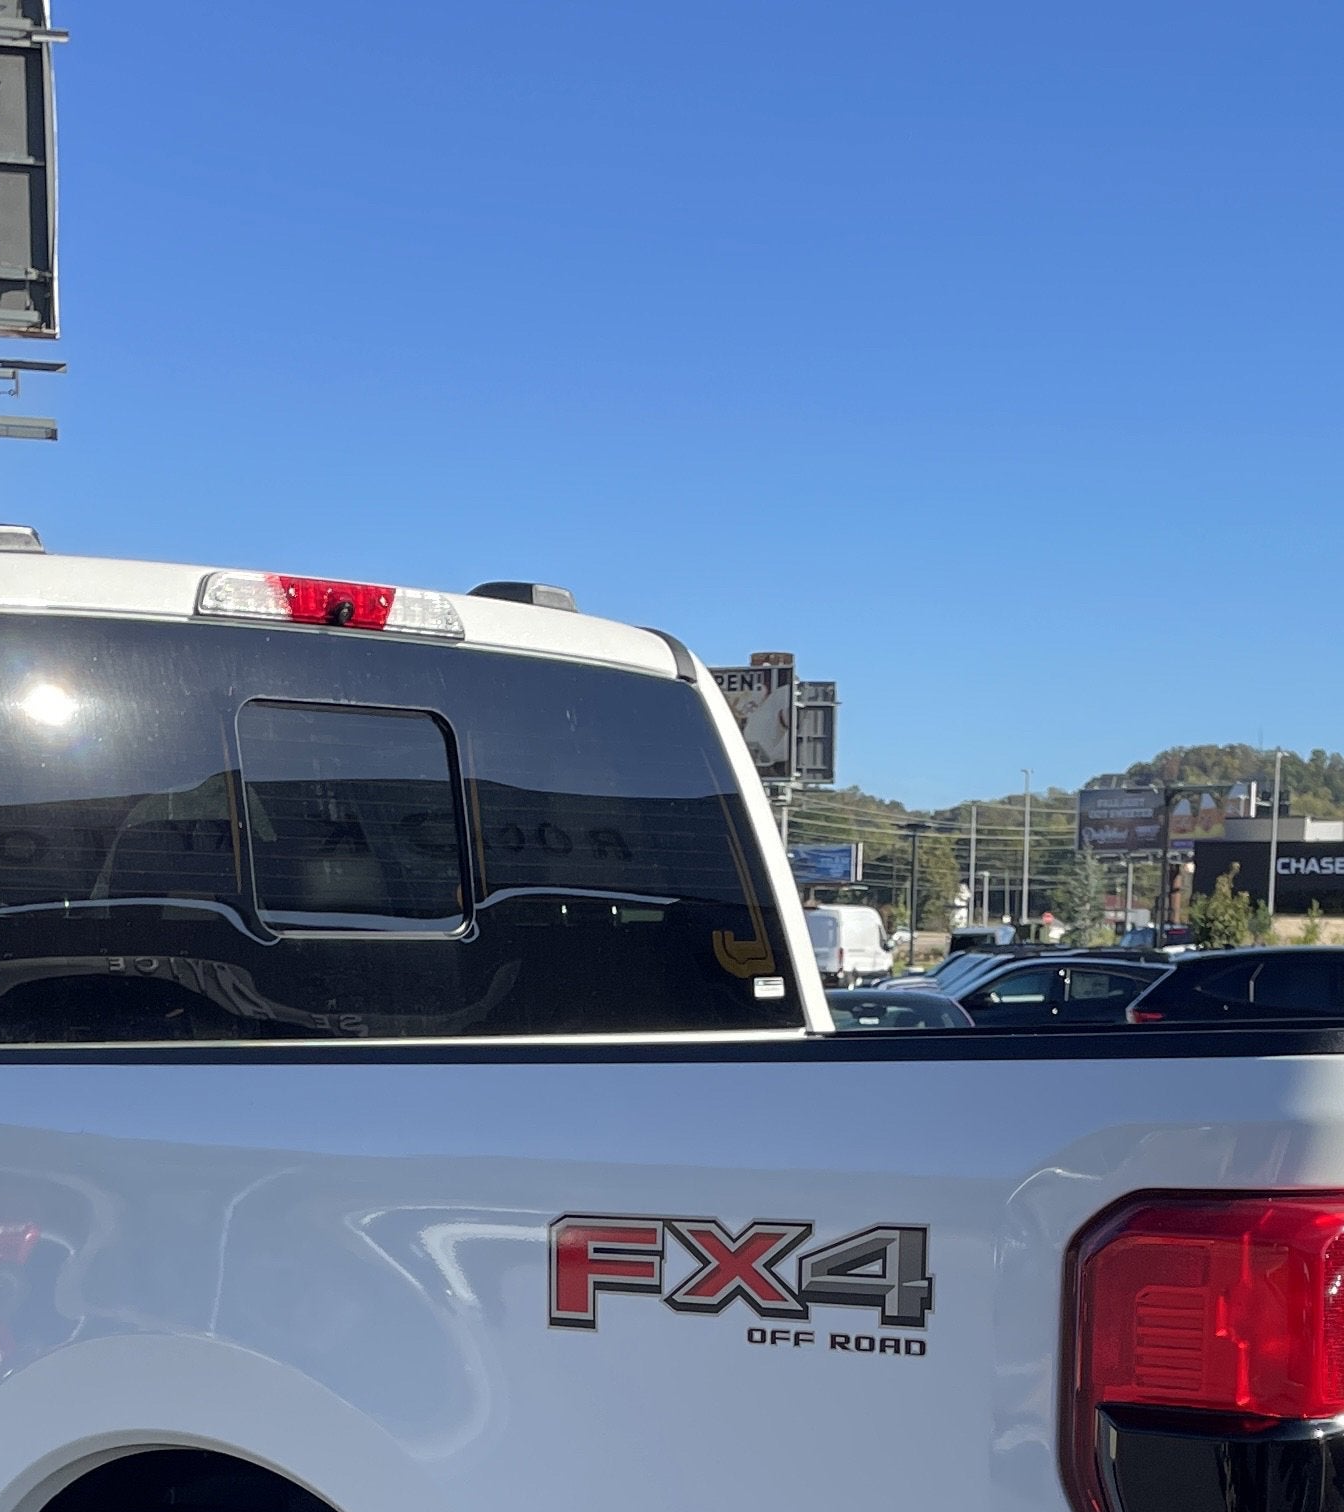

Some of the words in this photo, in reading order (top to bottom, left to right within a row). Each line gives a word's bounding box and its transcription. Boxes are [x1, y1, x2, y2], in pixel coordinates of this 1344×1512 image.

[713, 672, 763, 692] PEN!
[547, 1212, 934, 1332] FX4
[746, 1328, 816, 1347] OFF
[829, 1333, 927, 1357] ROAD
